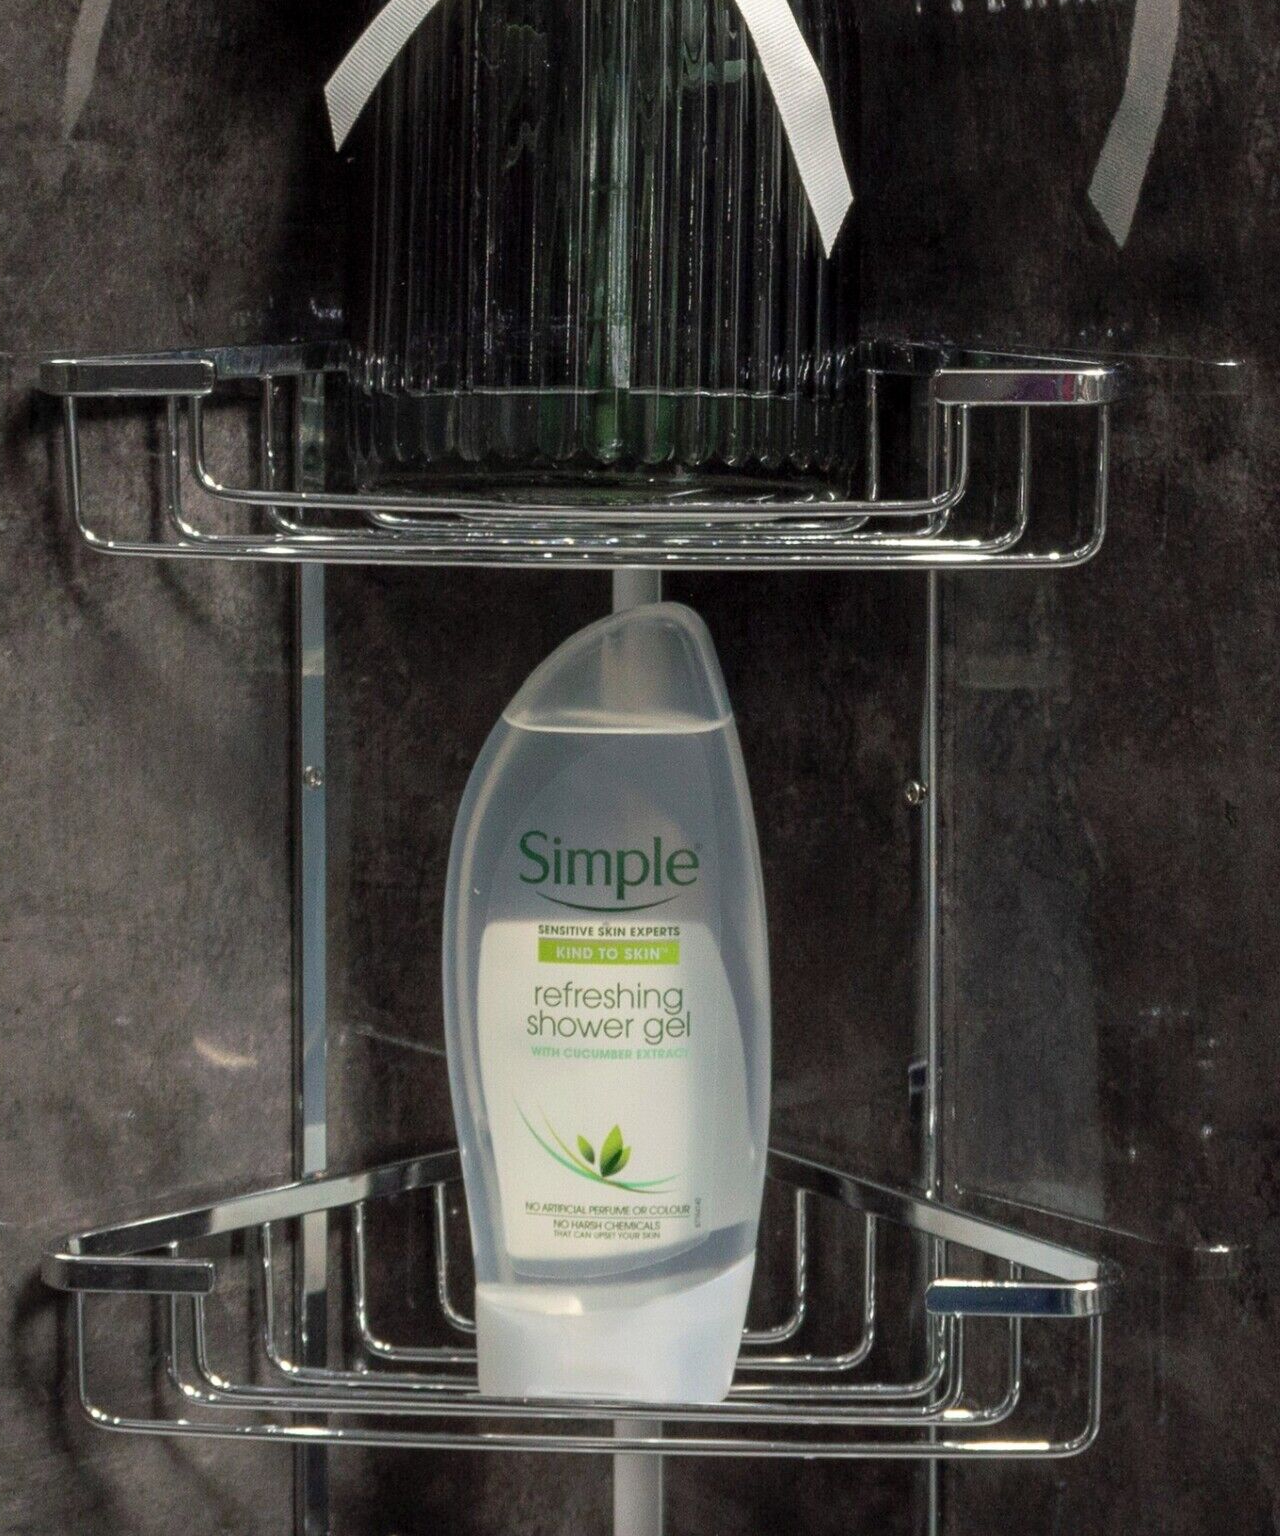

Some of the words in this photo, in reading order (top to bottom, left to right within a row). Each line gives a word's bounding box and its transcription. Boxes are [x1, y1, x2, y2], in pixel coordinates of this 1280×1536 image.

[519, 830, 700, 901] Simple
[538, 925, 594, 936] SENSITIVE
[598, 926, 626, 936] SKIN
[631, 926, 680, 936] EXPERTS
[556, 948, 593, 960] KIND
[598, 949, 618, 960] TO
[535, 982, 683, 1015] refreshing
[527, 1010, 634, 1038] shower
[644, 1011, 691, 1044] gel
[531, 1046, 560, 1058] WITH
[650, 1204, 690, 1215] COLOUR
